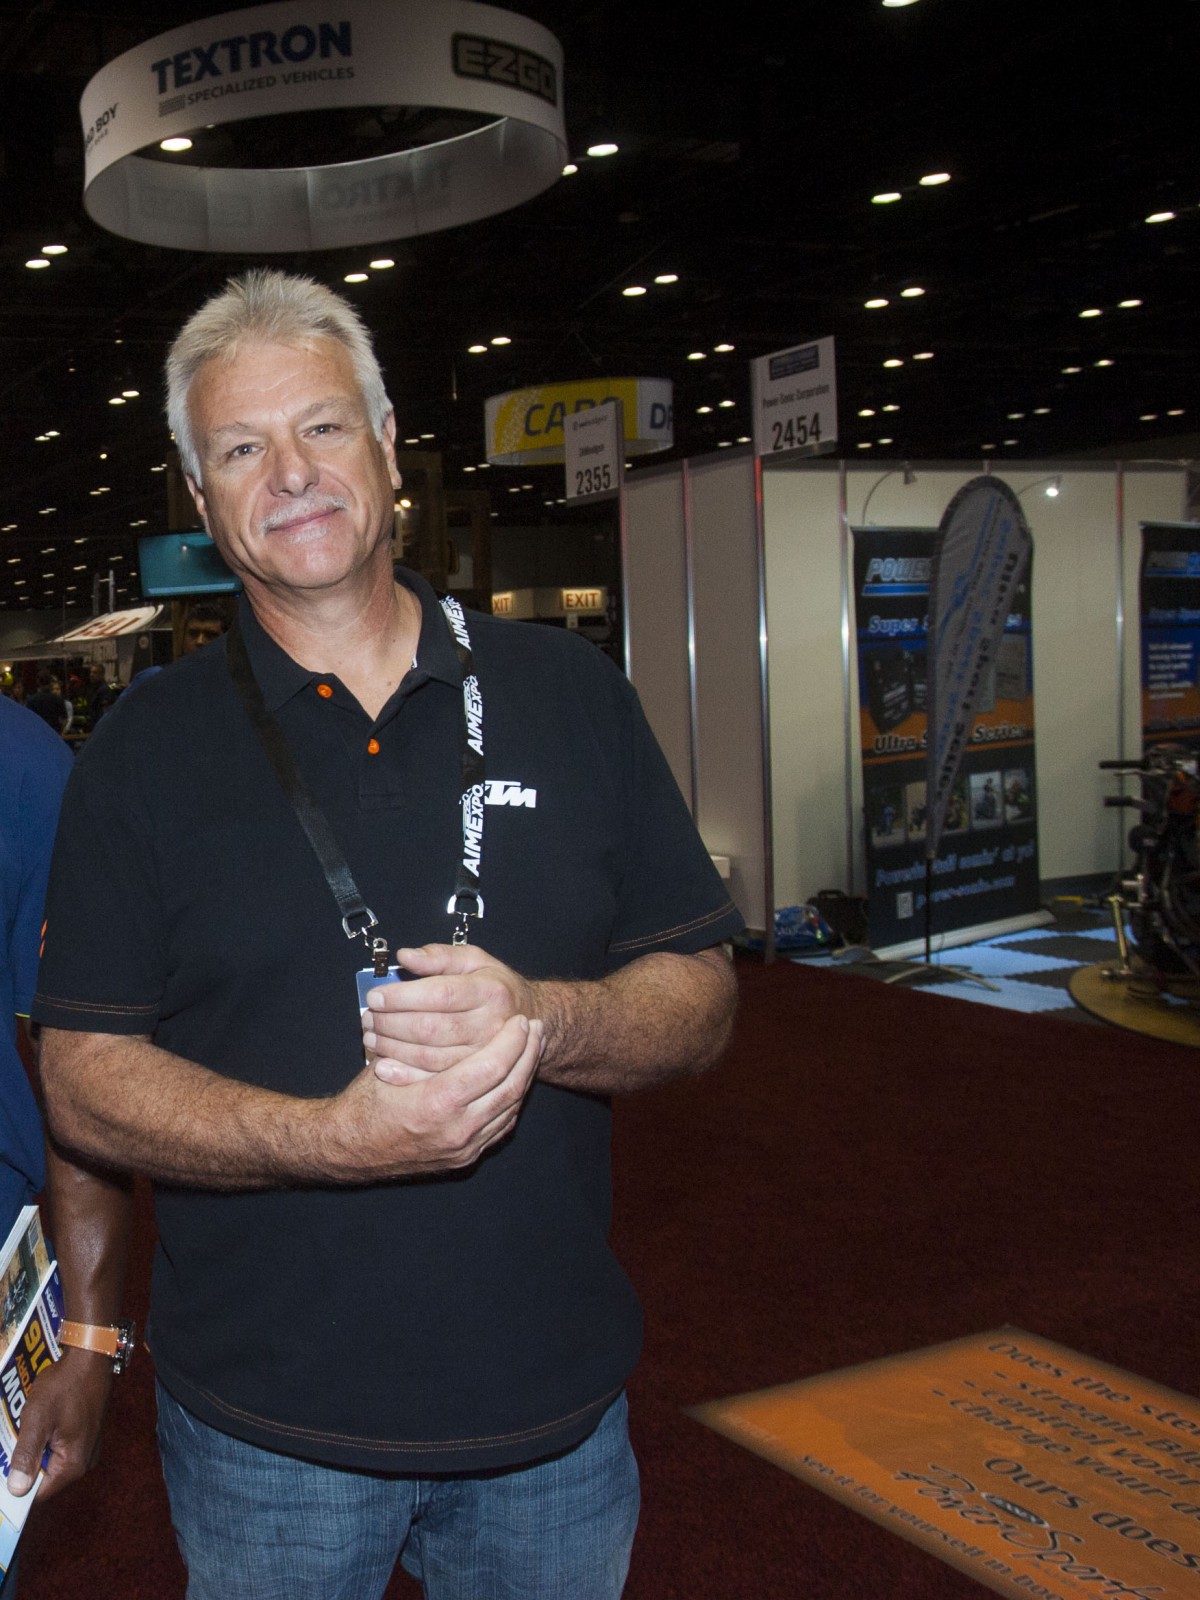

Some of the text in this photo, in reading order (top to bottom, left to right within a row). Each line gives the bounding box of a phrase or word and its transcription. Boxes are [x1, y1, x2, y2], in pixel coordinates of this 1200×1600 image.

[151, 21, 351, 95] TEXTRON
[186, 66, 355, 106] SPECIALIZED VEHICLES
[95, 102, 119, 133] BOY
[772, 412, 822, 451] 2454
[575, 463, 612, 496] 2355
[493, 597, 510, 612] XIT
[565, 592, 599, 608] EXIT
[869, 614, 920, 637] Super
[466, 675, 484, 757] AIMEXPO
[873, 734, 918, 753] Ultra
[462, 783, 485, 878] AIMEXPO
[1, 1366, 27, 1428] OW
[989, 1341, 1063, 1378] Does
[1072, 1376, 1131, 1402] the
[1018, 1380, 1144, 1438] stream
[949, 1397, 1175, 1499] charge your
[982, 1388, 1200, 1487] control your
[984, 1456, 1083, 1509] Ours
